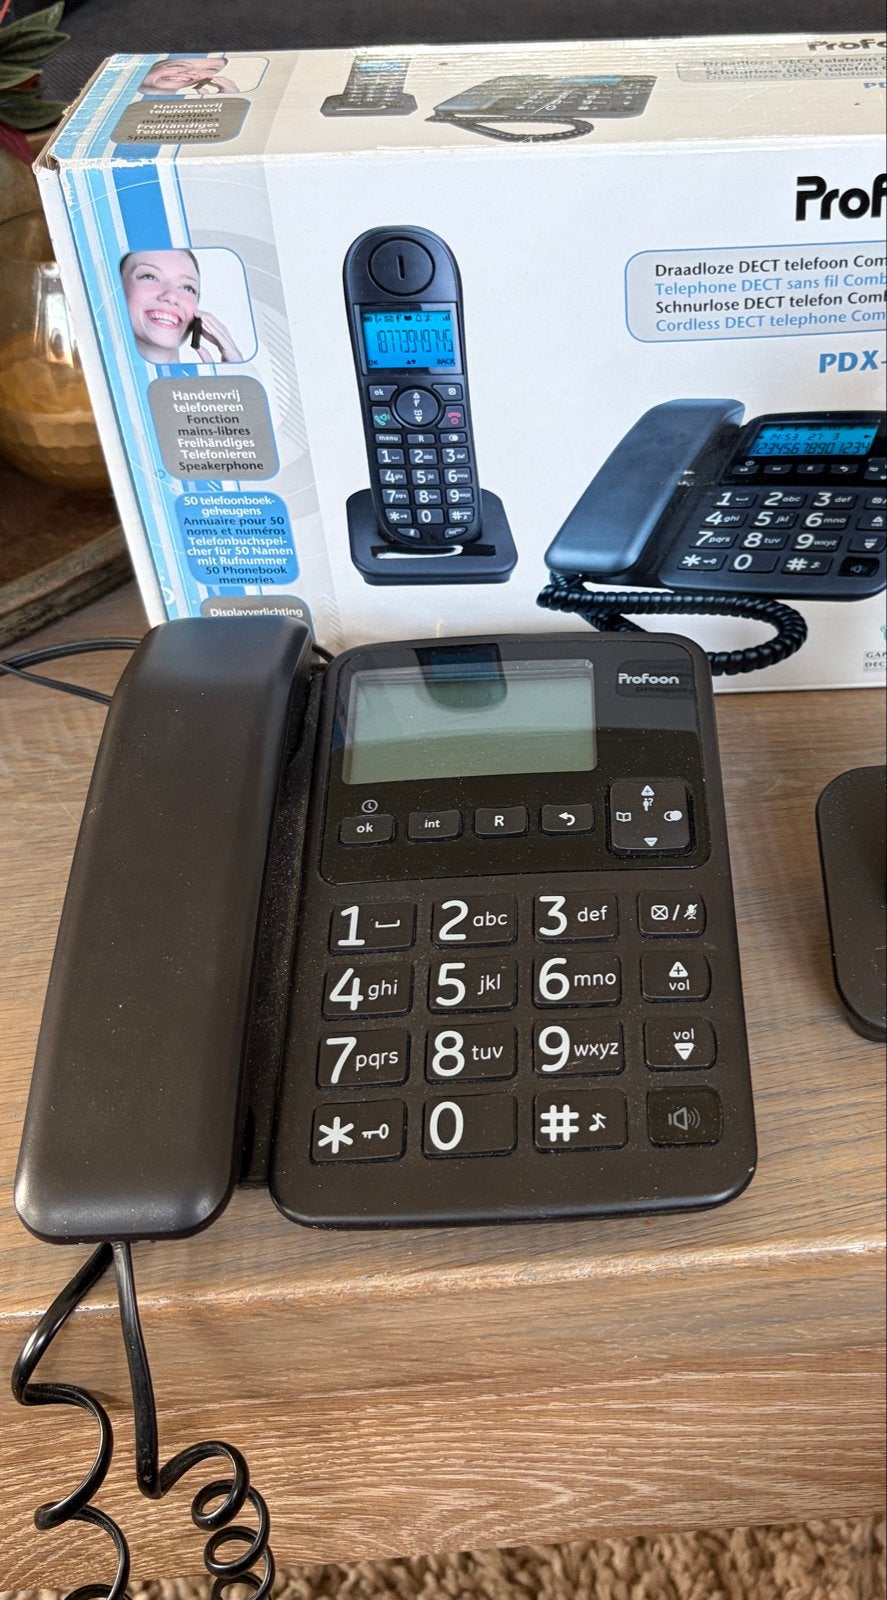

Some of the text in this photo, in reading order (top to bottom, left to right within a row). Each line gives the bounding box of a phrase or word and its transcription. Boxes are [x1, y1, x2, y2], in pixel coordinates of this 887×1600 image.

[655, 262, 734, 277] Draadloze
[739, 259, 780, 274] DECT
[784, 256, 848, 272] telefoon
[654, 280, 737, 298] Telephone
[741, 277, 782, 292] DECT
[787, 278, 819, 290] sans
[824, 275, 838, 288] fil
[655, 290, 886, 314] Schnurlose DECT telefon Com
[655, 309, 885, 332] Cordless DECT telephone Com
[172, 390, 241, 402] Handenvrij
[374, 388, 384, 396] ok
[174, 402, 244, 412] telefoneren
[186, 415, 240, 424] Fonction
[177, 426, 251, 436] mains-libres
[178, 438, 255, 450] Freihändiges
[180, 449, 257, 459] Telefonieren
[381, 450, 392, 463] 1
[414, 450, 424, 463] 2
[446, 449, 456, 462] 3
[179, 461, 264, 472] Speakerphone
[385, 471, 395, 483] 4
[416, 471, 426, 484] 5
[448, 470, 458, 483] 6
[183, 495, 276, 506] 50 telefoonboek-
[387, 490, 396, 503] 7
[419, 490, 429, 503] 8
[450, 489, 460, 503] 9
[716, 492, 732, 506] 1
[764, 492, 783, 506] 2
[813, 492, 832, 507] 3
[201, 506, 262, 518] geheugens
[421, 510, 432, 523] 0
[705, 511, 741, 525] 4 ghi
[754, 511, 773, 526] 5
[183, 516, 285, 528] Annuaire pour 50
[805, 513, 846, 527] 6 mno
[186, 526, 286, 536] noms et numéros
[188, 537, 288, 548] Telefonbuchspei-
[696, 531, 731, 546] 7 pqrs
[743, 532, 763, 548] 8
[795, 533, 837, 549] 9 wxyz
[187, 546, 293, 556] cher für 50 Namen
[198, 556, 288, 565] mit Rufnummer
[733, 554, 752, 570] 0
[205, 565, 287, 575] 50 Phonebook
[219, 576, 275, 584] memories
[618, 672, 680, 684] Profoon
[424, 817, 441, 829] int
[494, 815, 505, 827] R
[356, 822, 374, 835] ok
[438, 899, 508, 941] 2 abc
[538, 895, 608, 936] 3 def
[337, 905, 366, 946] 1
[435, 962, 501, 1006] 5 jkl
[538, 957, 617, 1000] 6 mno
[328, 967, 399, 1011] 4 ghi
[668, 980, 690, 991] vol
[673, 1028, 695, 1040] vol
[431, 1030, 503, 1076] 8 tuv
[538, 1025, 619, 1072] 9 wxyz
[326, 1036, 399, 1084] 7 pqrs
[429, 1101, 464, 1151] 0
